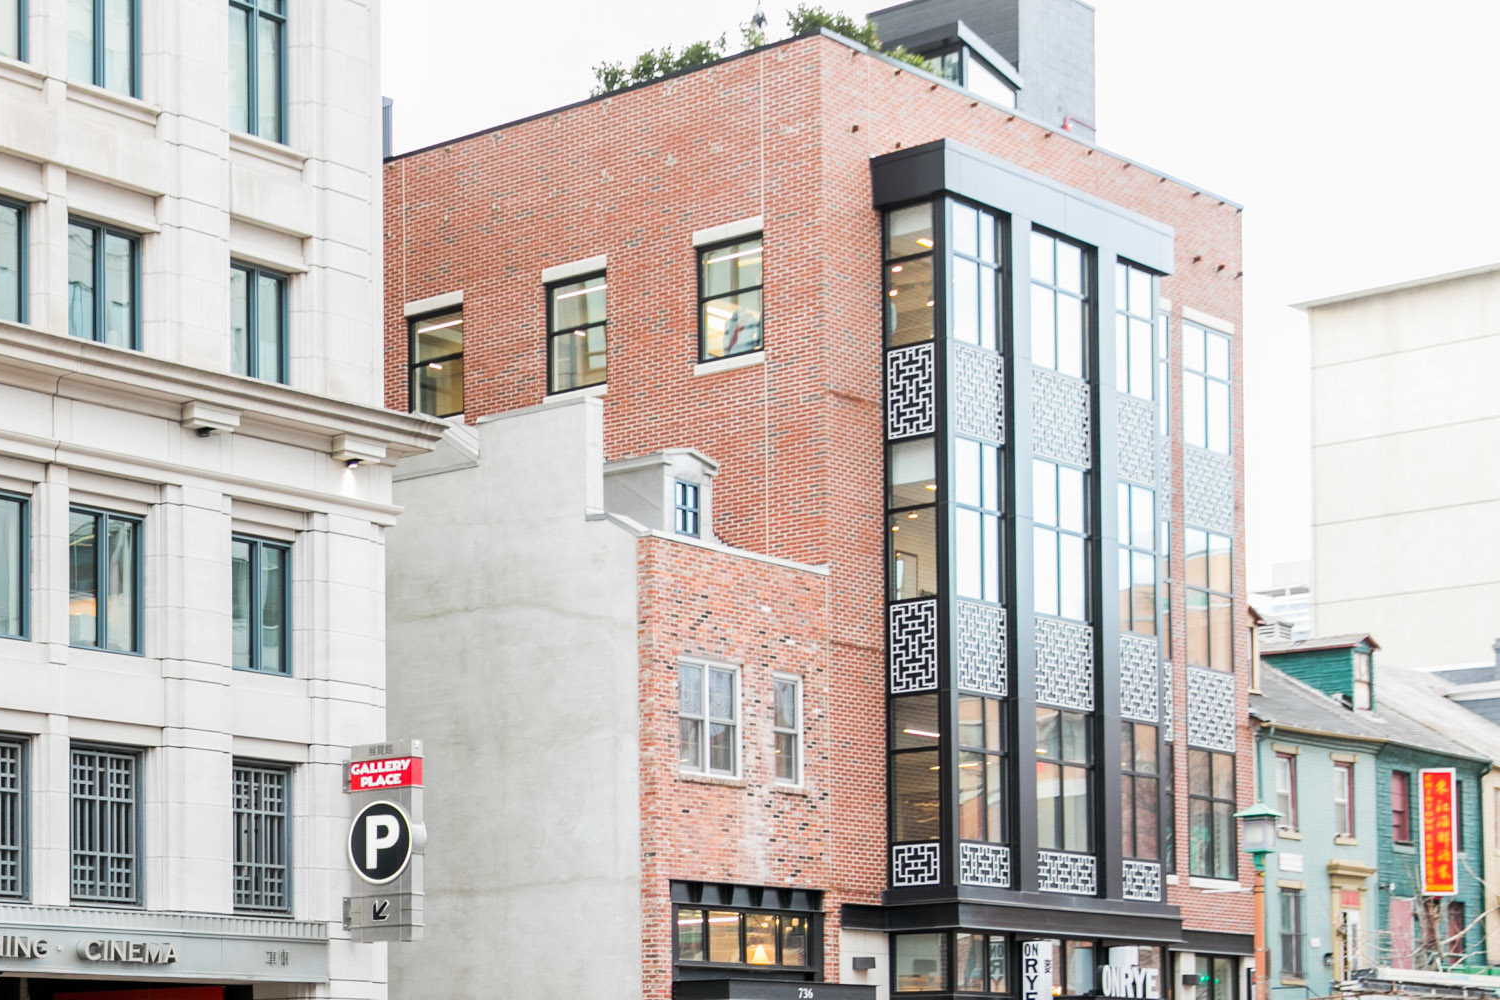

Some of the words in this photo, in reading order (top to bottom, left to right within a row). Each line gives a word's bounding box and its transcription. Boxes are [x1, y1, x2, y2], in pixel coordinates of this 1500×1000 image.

[351, 759, 411, 775] GALLERY
[360, 773, 402, 788] PLACE
[365, 814, 400, 870] P
[82, 939, 178, 964] CINEMA
[1024, 943, 1039, 957] ON
[797, 988, 814, 999] 736
